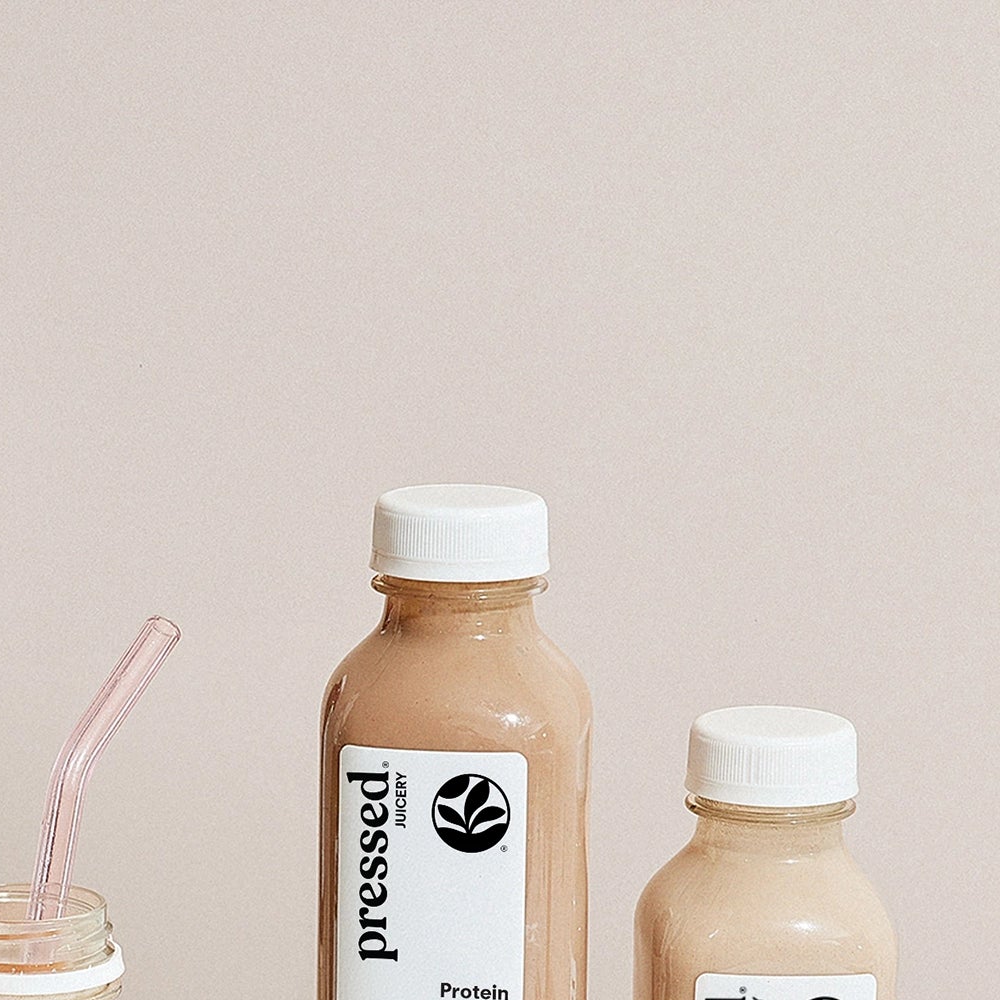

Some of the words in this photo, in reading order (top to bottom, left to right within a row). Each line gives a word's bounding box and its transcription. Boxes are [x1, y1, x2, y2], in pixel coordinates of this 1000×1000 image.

[395, 772, 407, 828] JUICERY
[347, 772, 398, 962] pressed
[441, 983, 509, 1000] Protein
